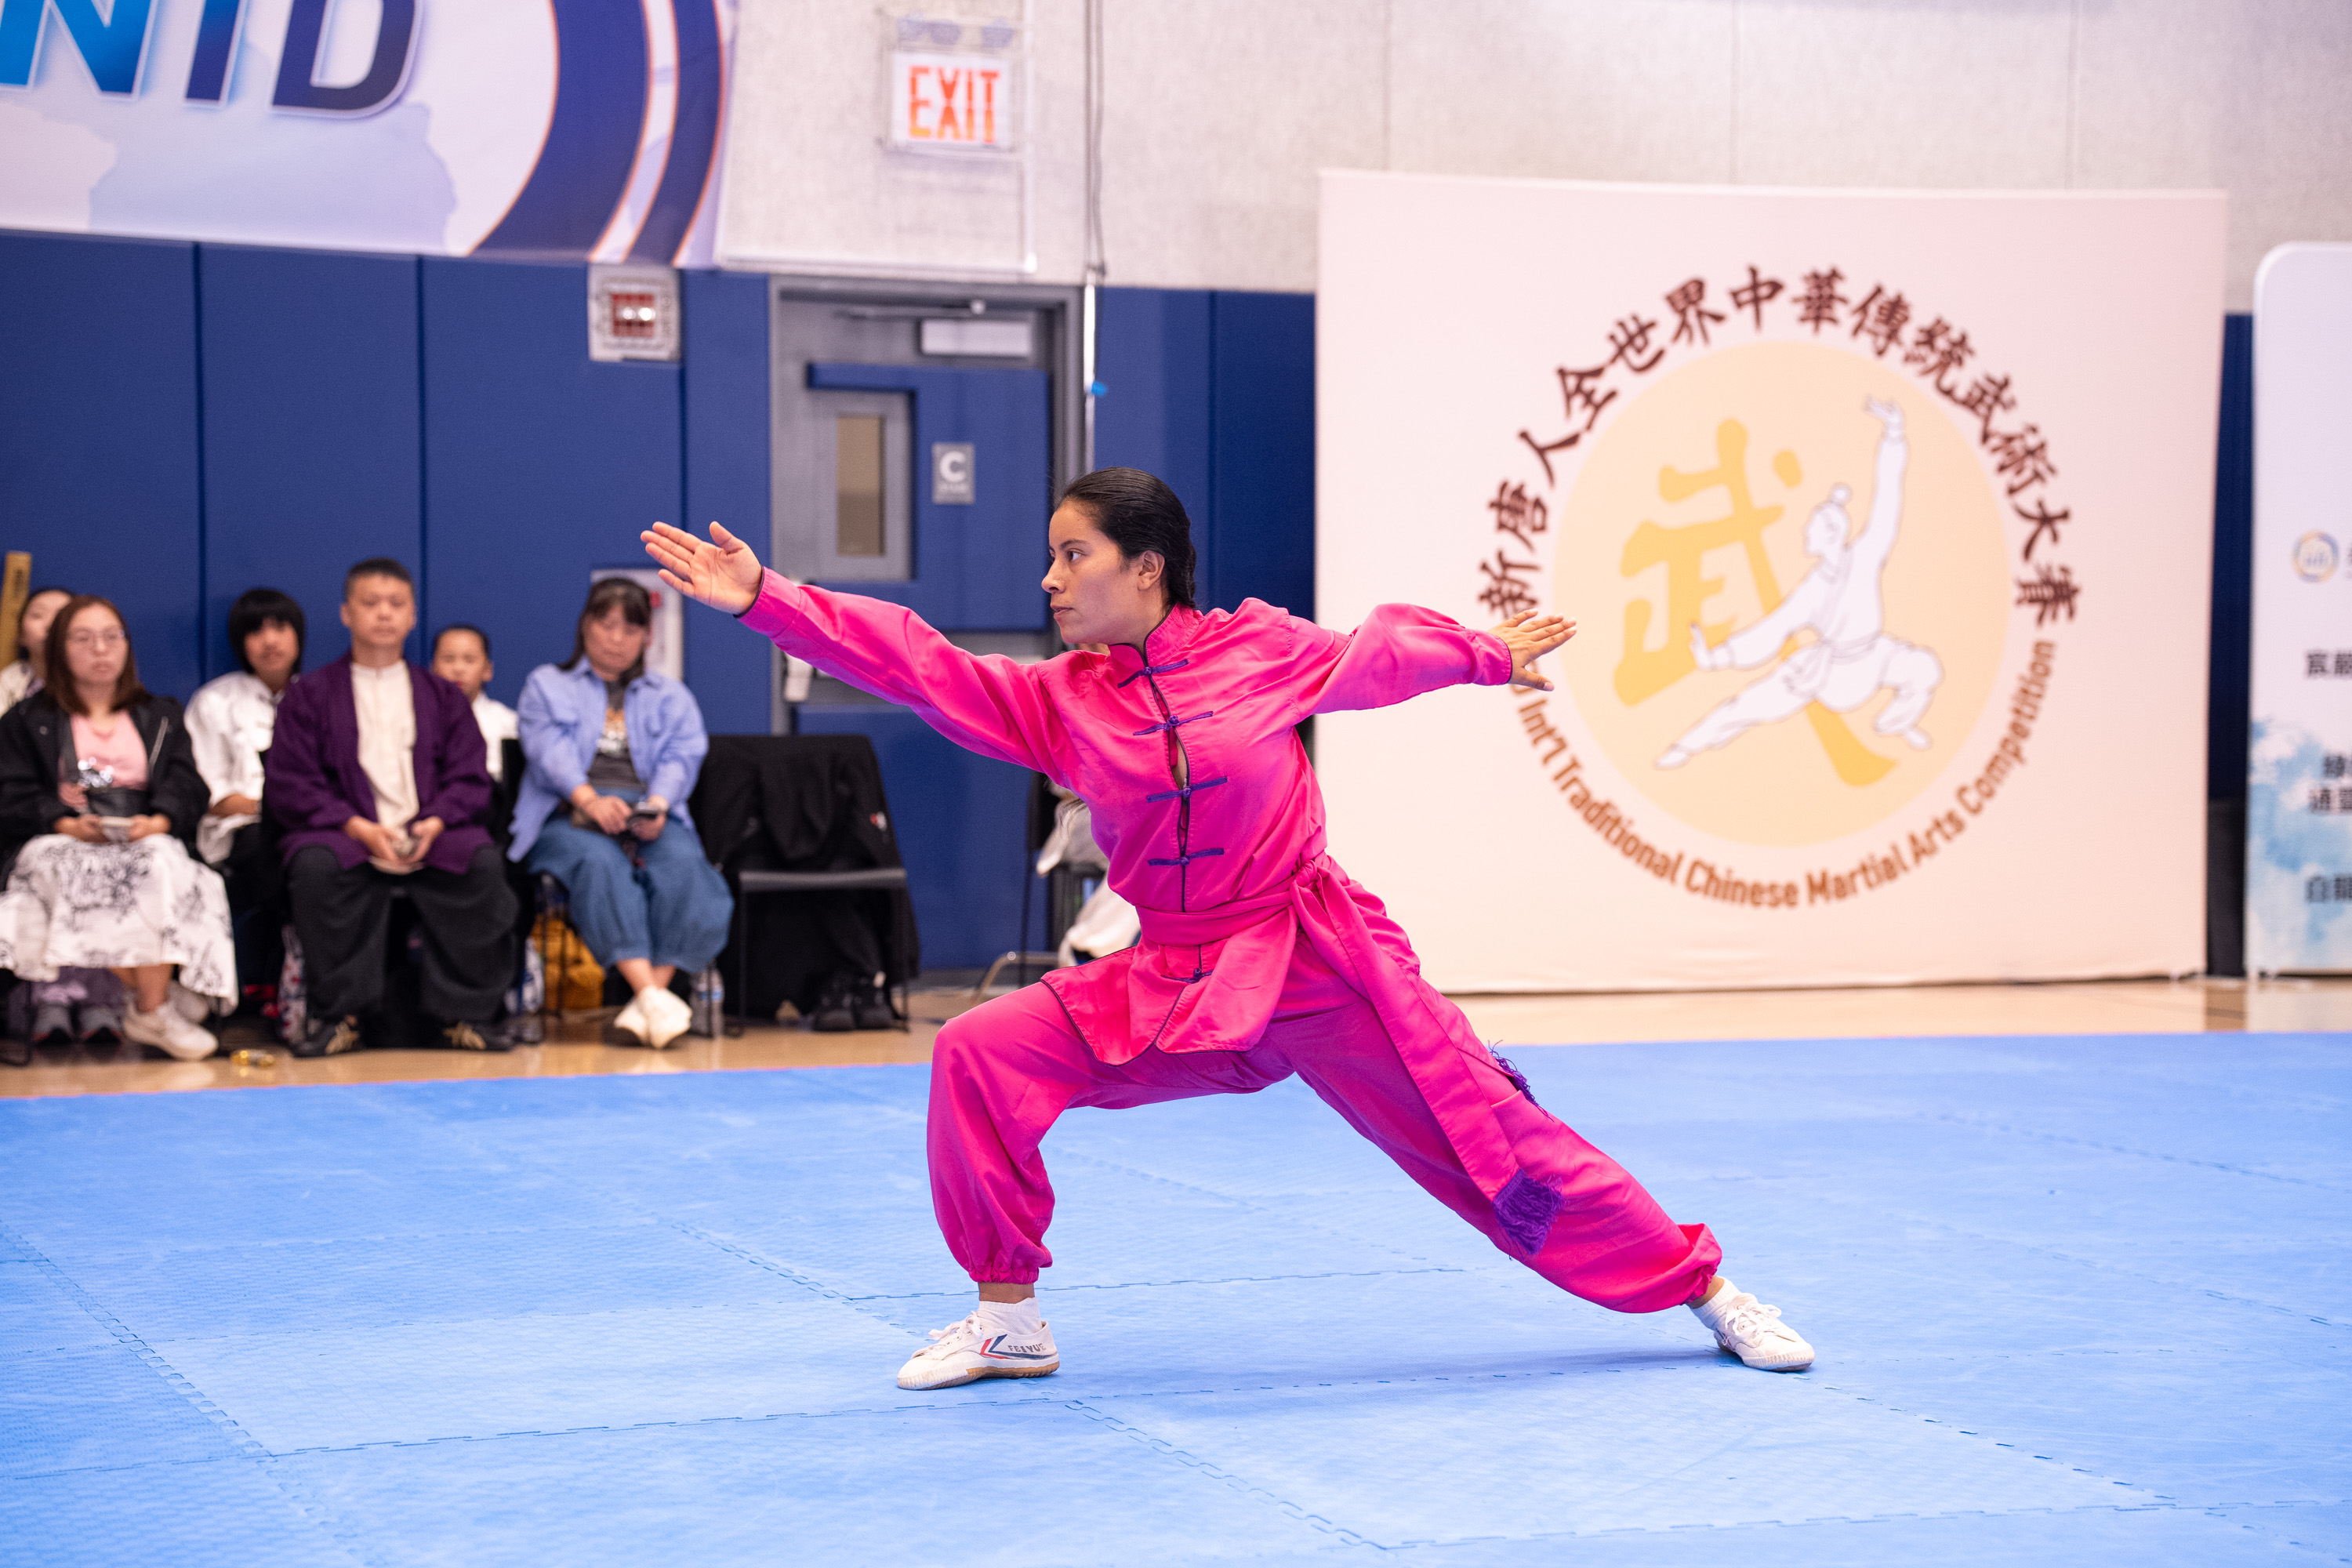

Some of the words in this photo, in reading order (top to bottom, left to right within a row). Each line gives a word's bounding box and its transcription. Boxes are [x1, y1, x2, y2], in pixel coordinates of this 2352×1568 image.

[909, 65, 999, 143] EXIT
[940, 452, 966, 482] C
[1553, 756, 1684, 883] Traditional
[1686, 859, 1798, 908] Chinese
[1806, 842, 1908, 905] Martial
[1908, 810, 1967, 866] Arts
[1955, 640, 2056, 815] Competition
[1007, 1343, 1047, 1352] FEIYUE
